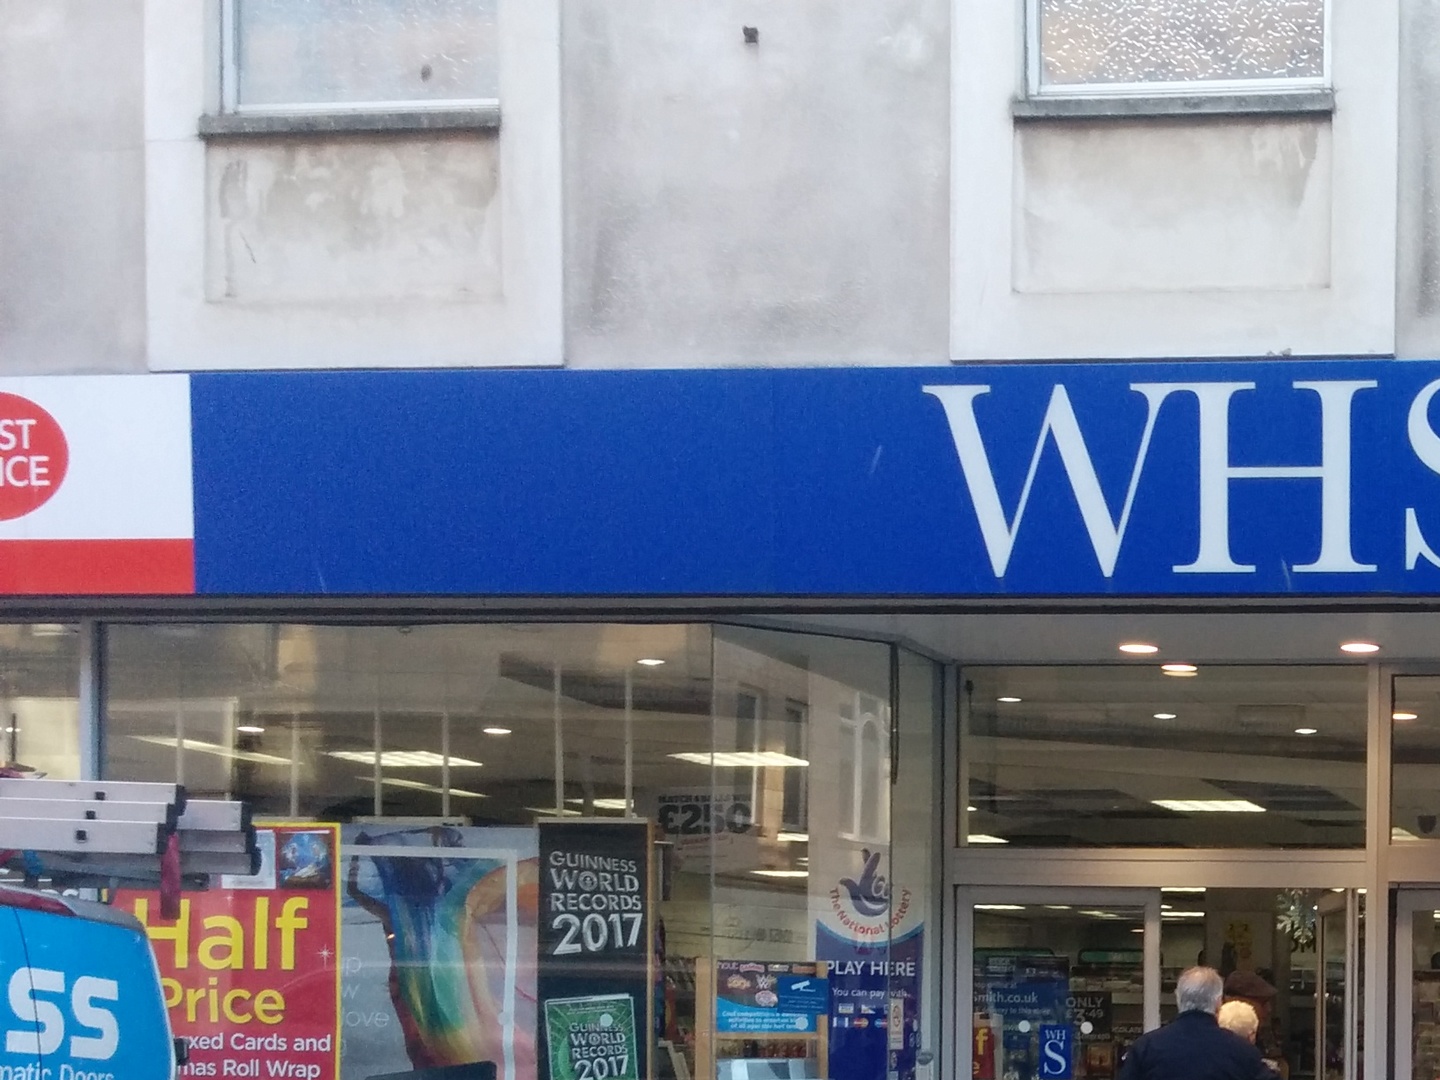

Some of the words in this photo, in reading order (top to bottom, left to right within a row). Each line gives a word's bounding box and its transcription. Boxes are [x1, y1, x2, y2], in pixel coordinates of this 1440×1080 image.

[549, 850, 637, 874] GUINNESS
[550, 868, 640, 893] WORLD
[549, 893, 643, 912] RECORDS
[836, 910, 886, 936] National
[135, 896, 308, 970] Half
[552, 912, 643, 956] 2017
[827, 960, 865, 976] PLAY
[870, 961, 916, 977] HERE
[832, 987, 849, 997] You
[850, 989, 867, 997] can
[869, 989, 885, 999] pay
[1065, 997, 1104, 1008] ONLY
[230, 1033, 287, 1051] Cards
[293, 1034, 331, 1052] and
[570, 1032, 626, 1047] WORLD
[1044, 1029, 1066, 1040] WH
[571, 1044, 628, 1060] RECORDS
[1043, 1039, 1066, 1075] S
[222, 1059, 260, 1077] Roll
[265, 1060, 321, 1080] Wrap
